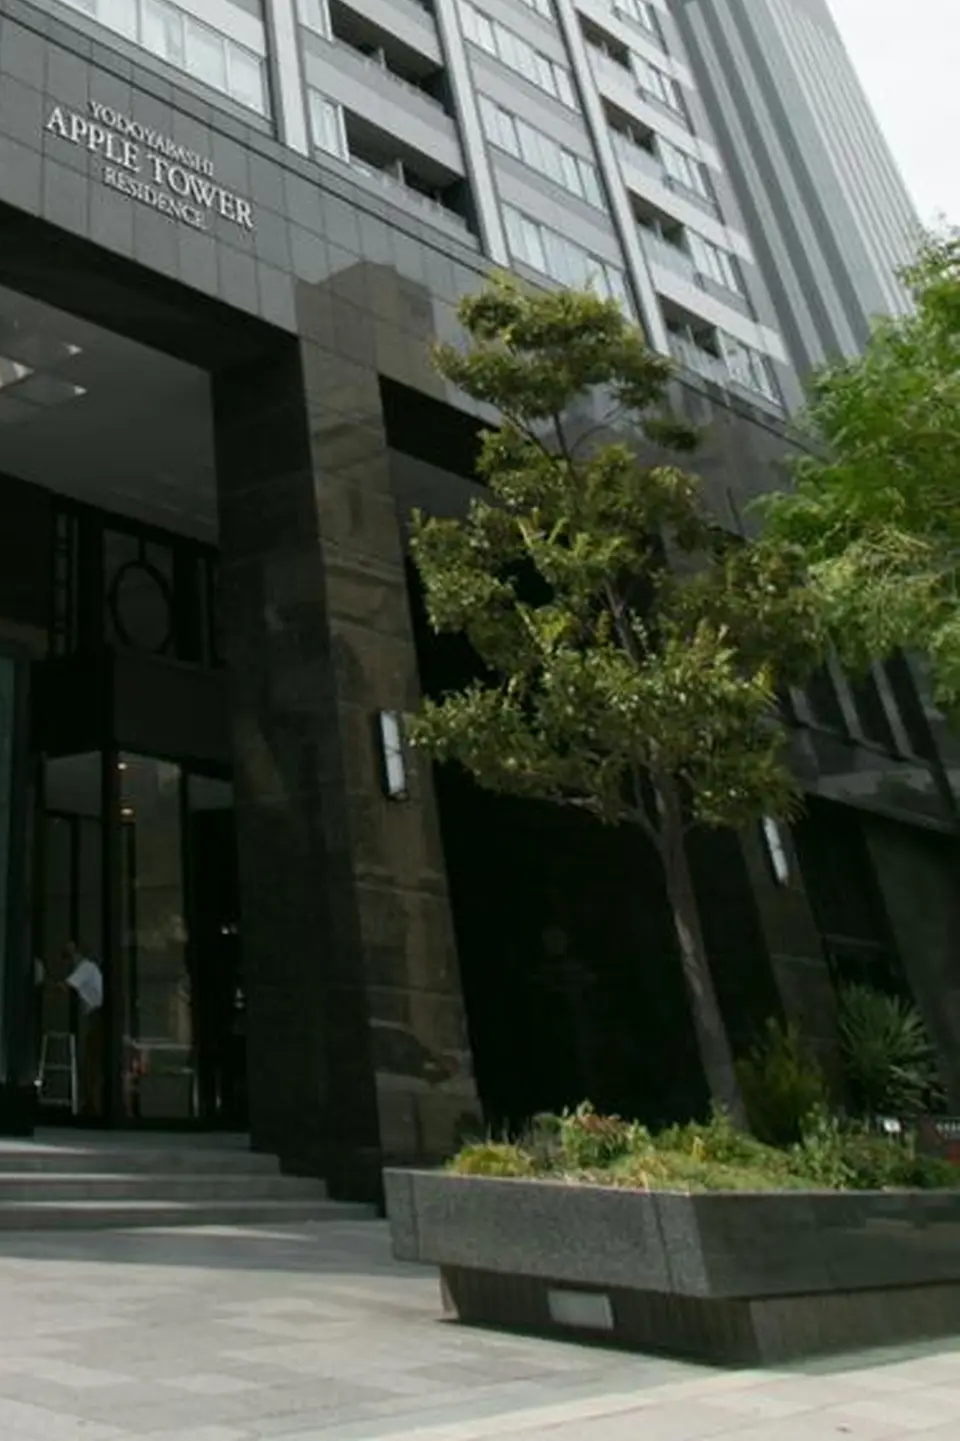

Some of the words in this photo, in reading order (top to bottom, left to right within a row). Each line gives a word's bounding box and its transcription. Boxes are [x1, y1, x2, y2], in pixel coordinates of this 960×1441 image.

[44, 105, 140, 173] APPLE
[146, 153, 254, 229] TOWER
[88, 100, 214, 176] YODOYABASHI
[102, 166, 207, 231] RESIDENCE
